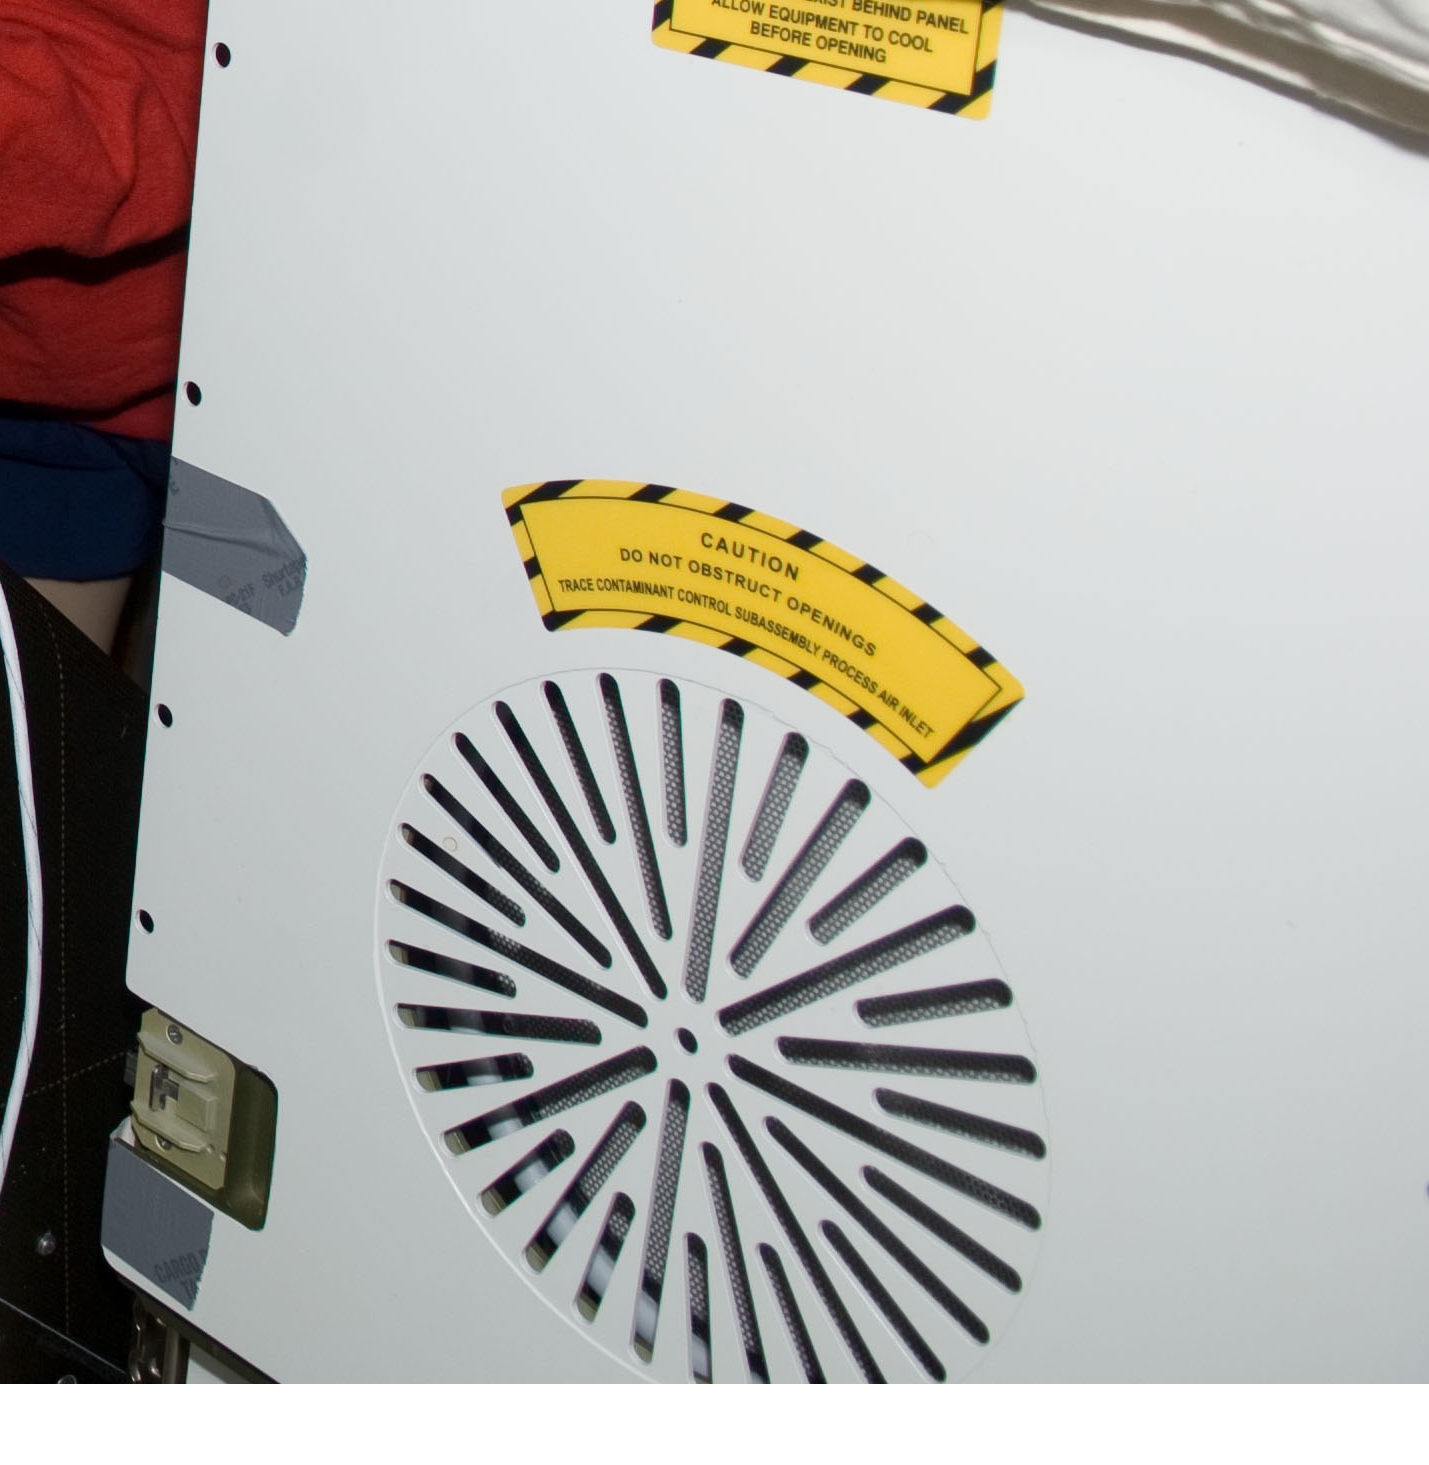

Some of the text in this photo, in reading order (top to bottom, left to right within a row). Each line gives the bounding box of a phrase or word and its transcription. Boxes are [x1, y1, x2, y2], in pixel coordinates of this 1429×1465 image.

[751, 22, 887, 63] BEFORE OPENING
[769, 5, 857, 36] EQUIPMENT
[864, 25, 884, 41] TO
[888, 30, 933, 52] COOL
[917, 10, 969, 34] PANEL
[701, 532, 801, 581] CAUTION
[620, 547, 877, 658] DO NOT OBSTRUCT OPENINGS
[558, 578, 935, 740] TRACE CONTAMINANT CONTROL SUBASSEMBLY PROCESS AIR INLET
